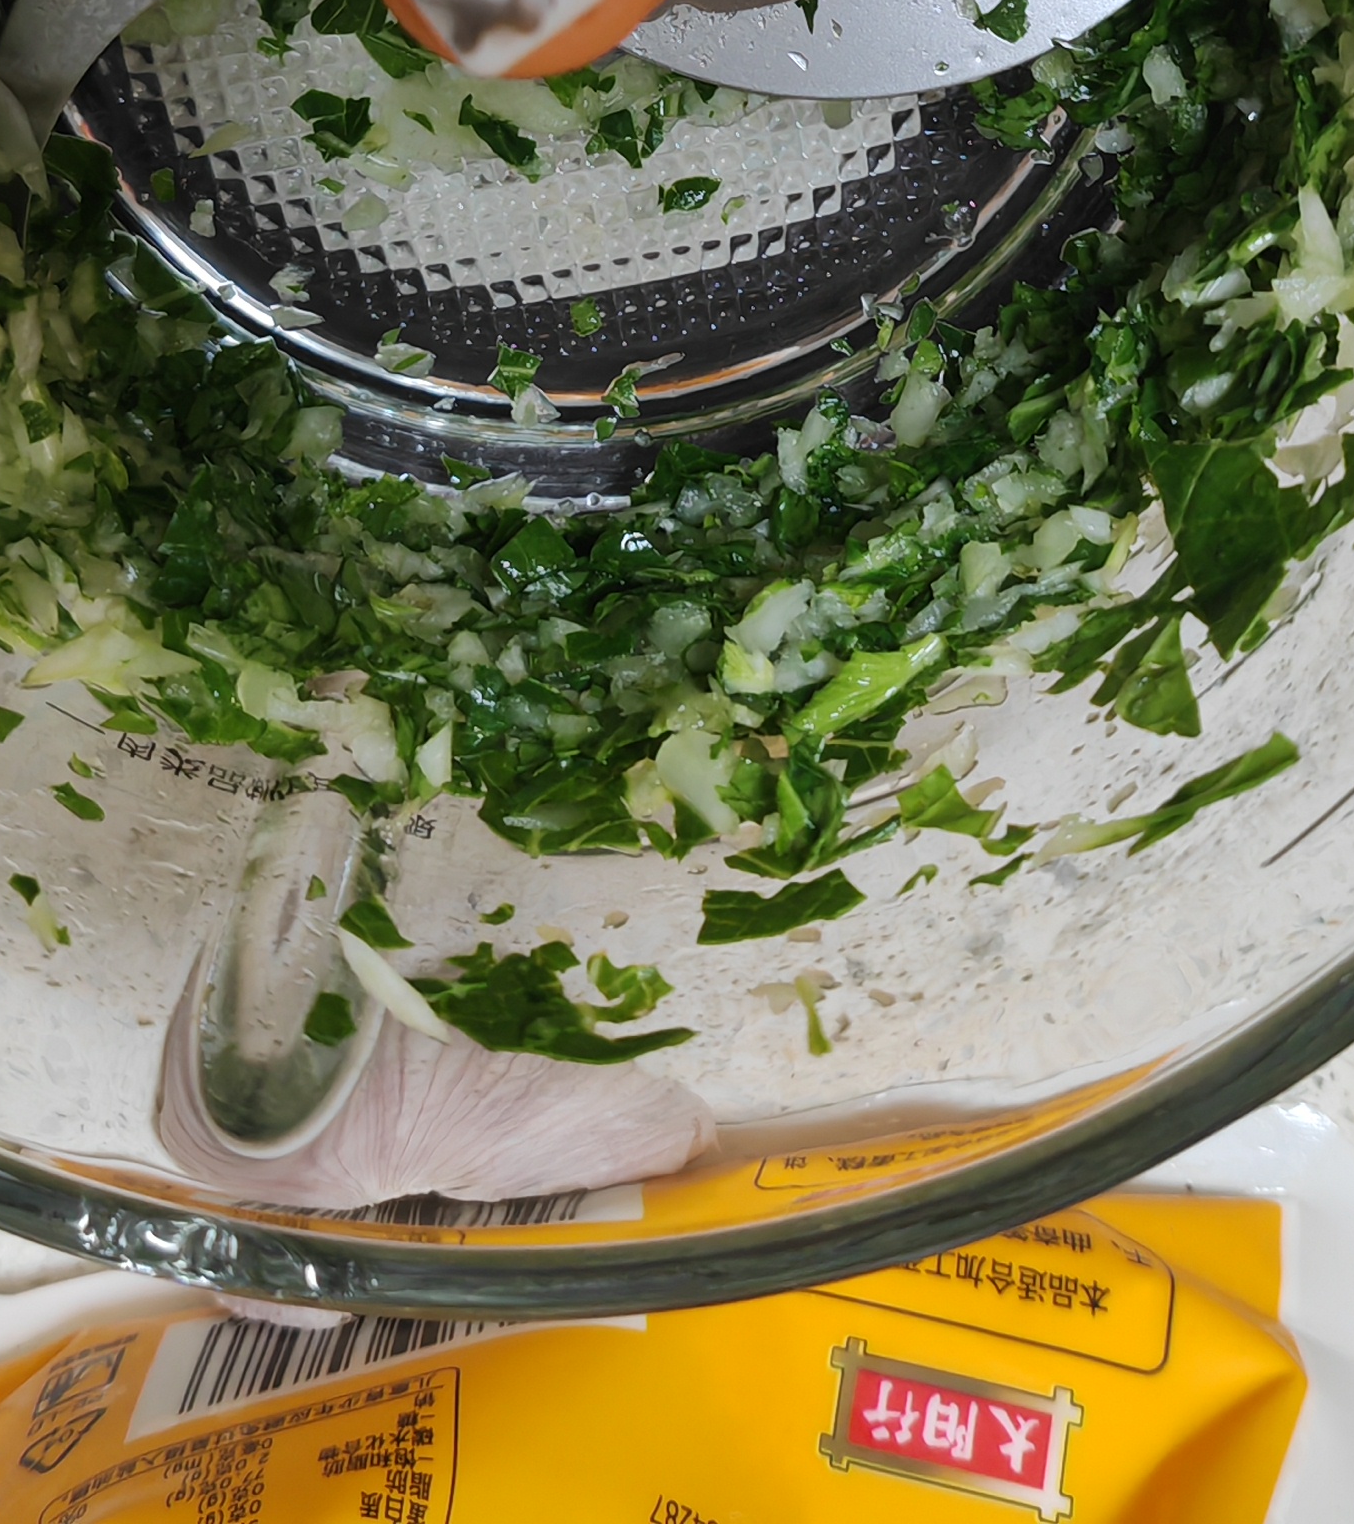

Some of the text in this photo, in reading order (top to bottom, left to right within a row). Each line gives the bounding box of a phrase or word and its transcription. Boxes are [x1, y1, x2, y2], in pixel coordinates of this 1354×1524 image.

[317, 1427, 435, 1462] 碳水化合物
[862, 1379, 1041, 1475] 太阳行
[385, 1468, 434, 1502] 脂肪
